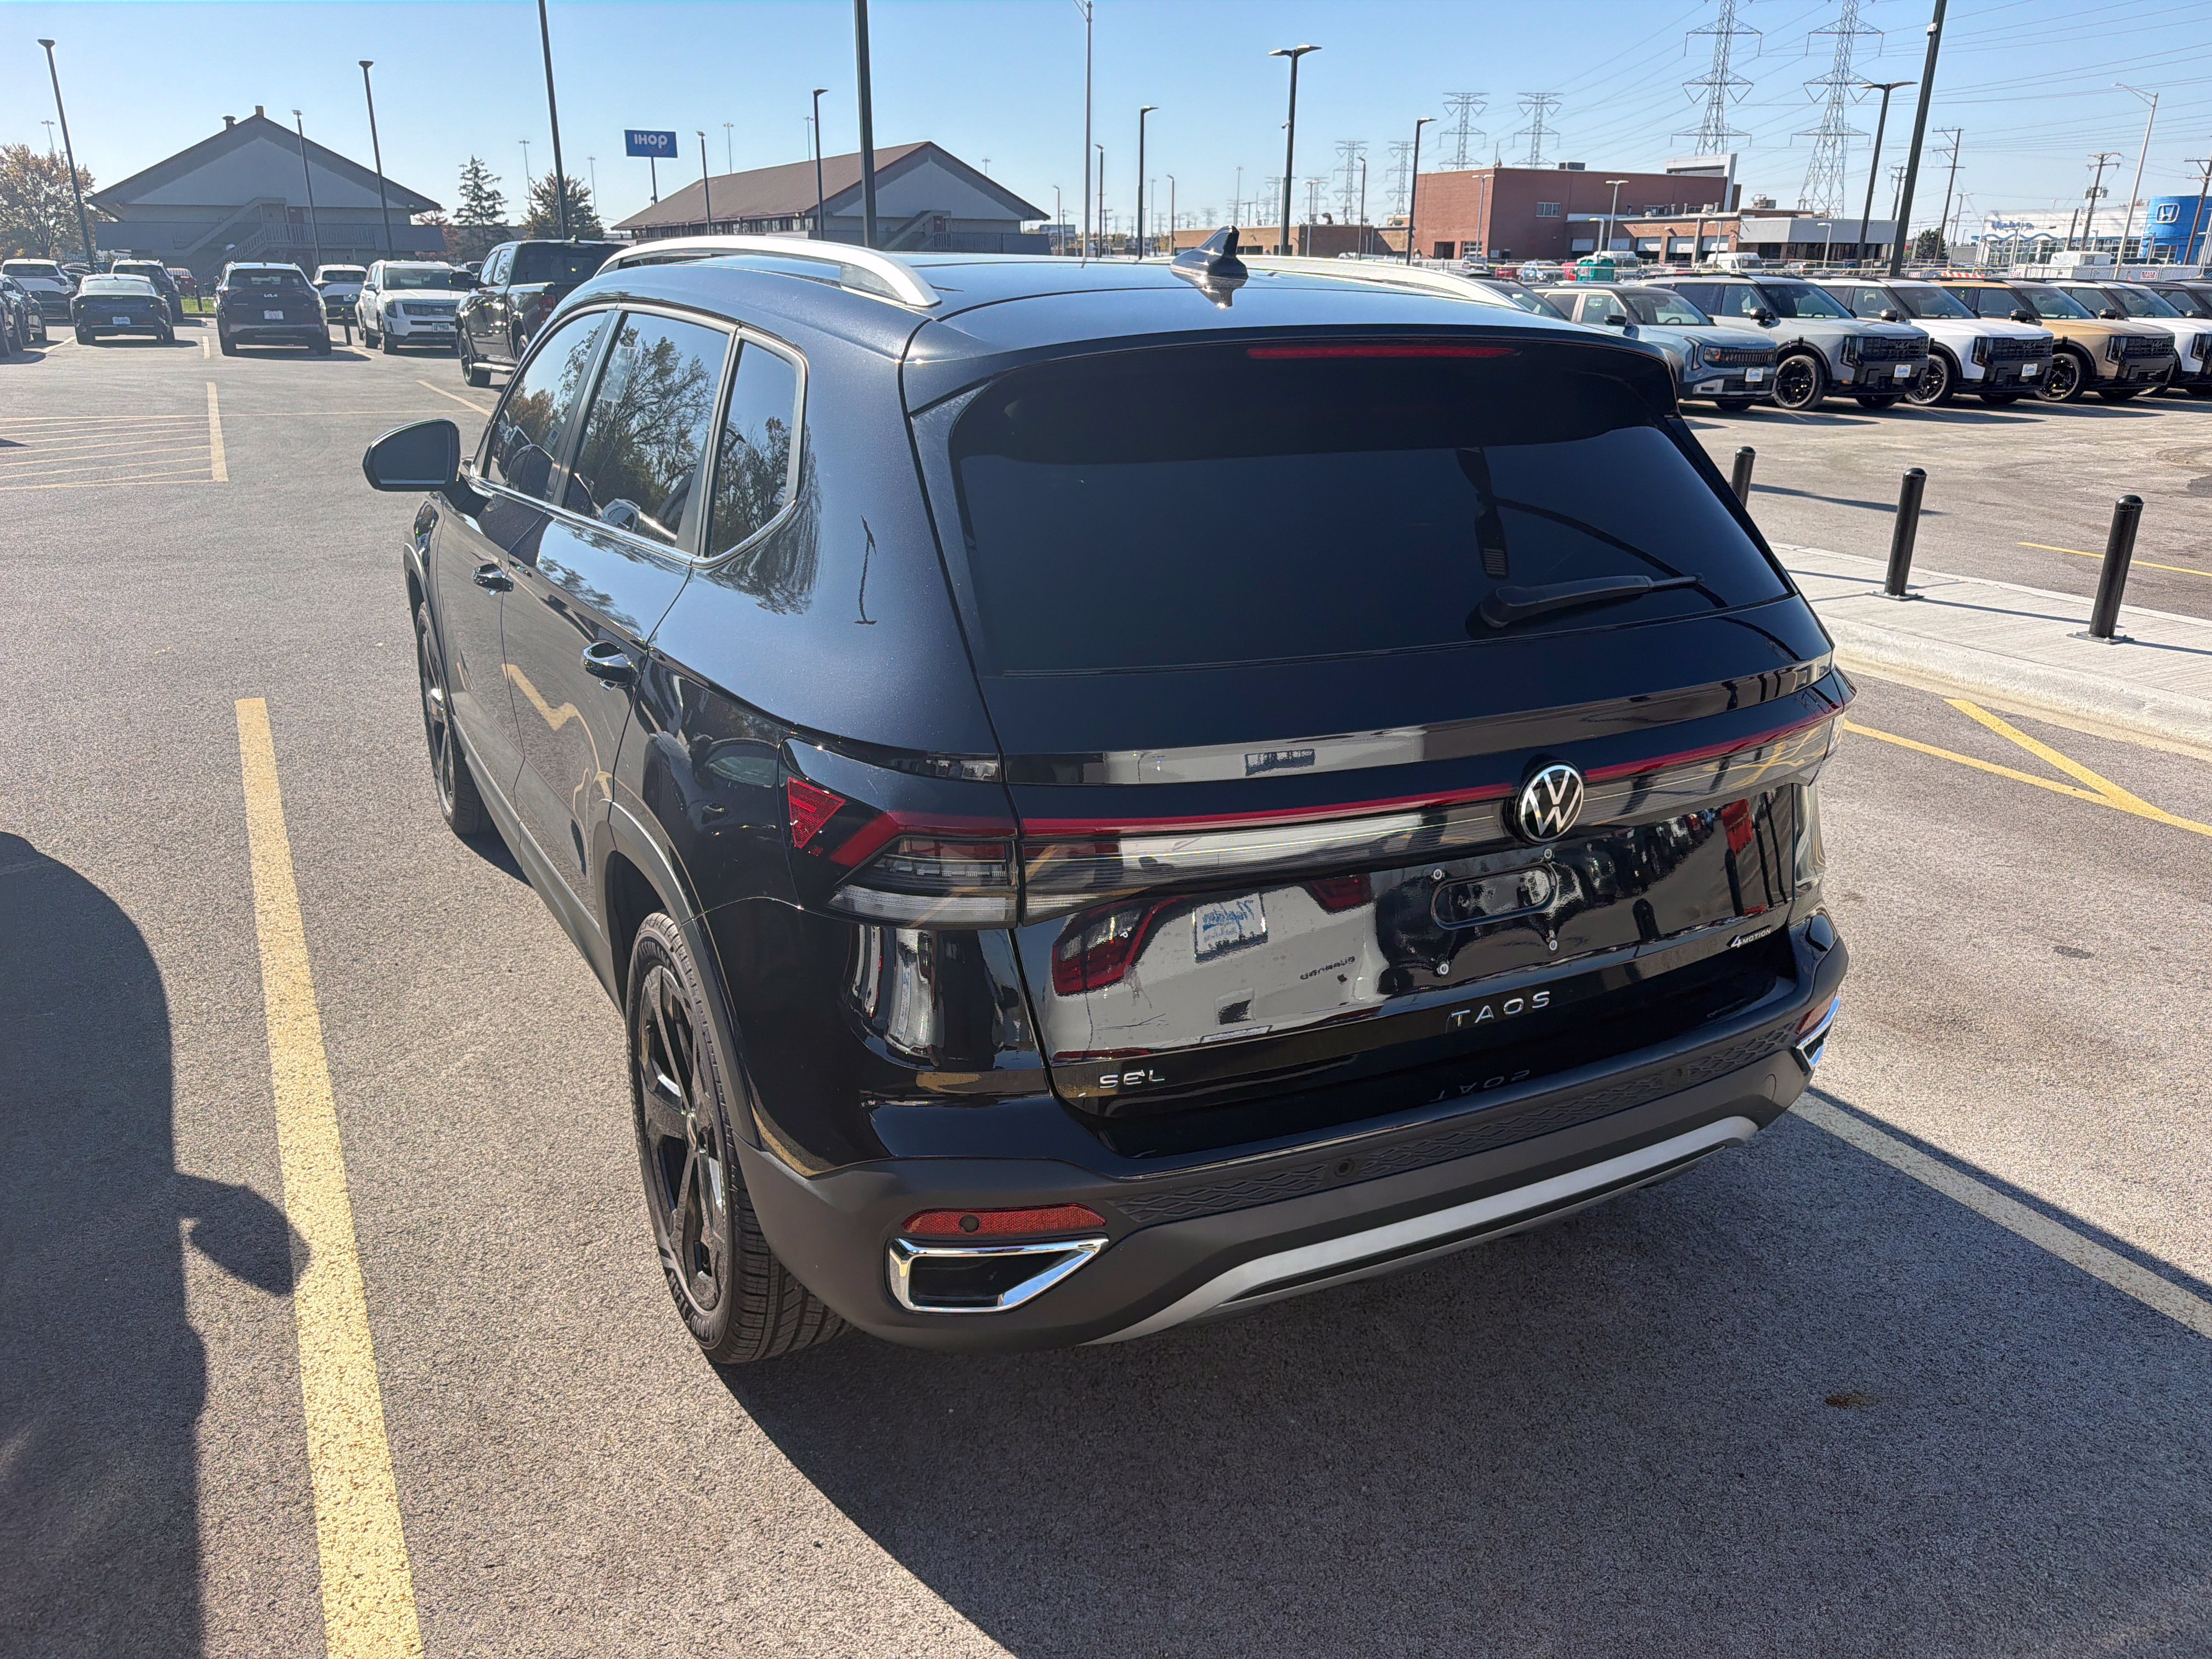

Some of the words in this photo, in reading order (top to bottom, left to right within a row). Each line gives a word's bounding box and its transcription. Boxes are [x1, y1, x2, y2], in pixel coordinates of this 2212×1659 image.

[1730, 928, 1772, 948] 4MOTION
[1451, 991, 1550, 1028] TAOS
[1099, 1069, 1165, 1088] SEL
